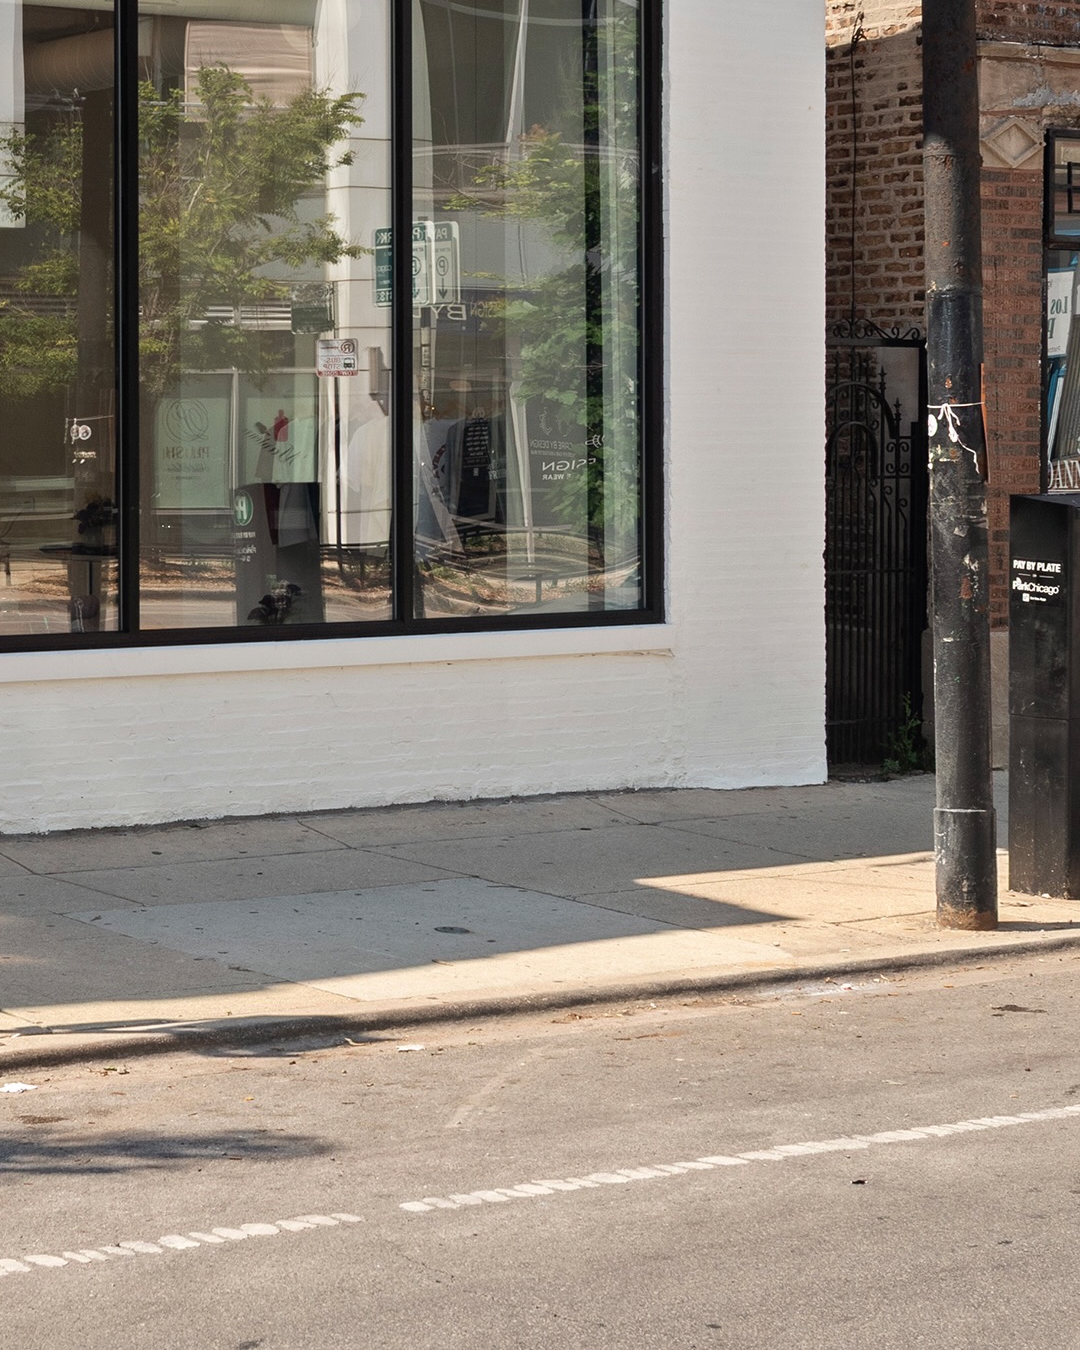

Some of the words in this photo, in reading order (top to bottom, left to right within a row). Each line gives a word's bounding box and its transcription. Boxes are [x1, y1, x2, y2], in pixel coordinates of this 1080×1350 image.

[1013, 559, 1027, 570] PAY
[1026, 561, 1037, 571] BY
[1036, 561, 1062, 574] PLATE
[1012, 577, 1060, 596] ParkChicago
